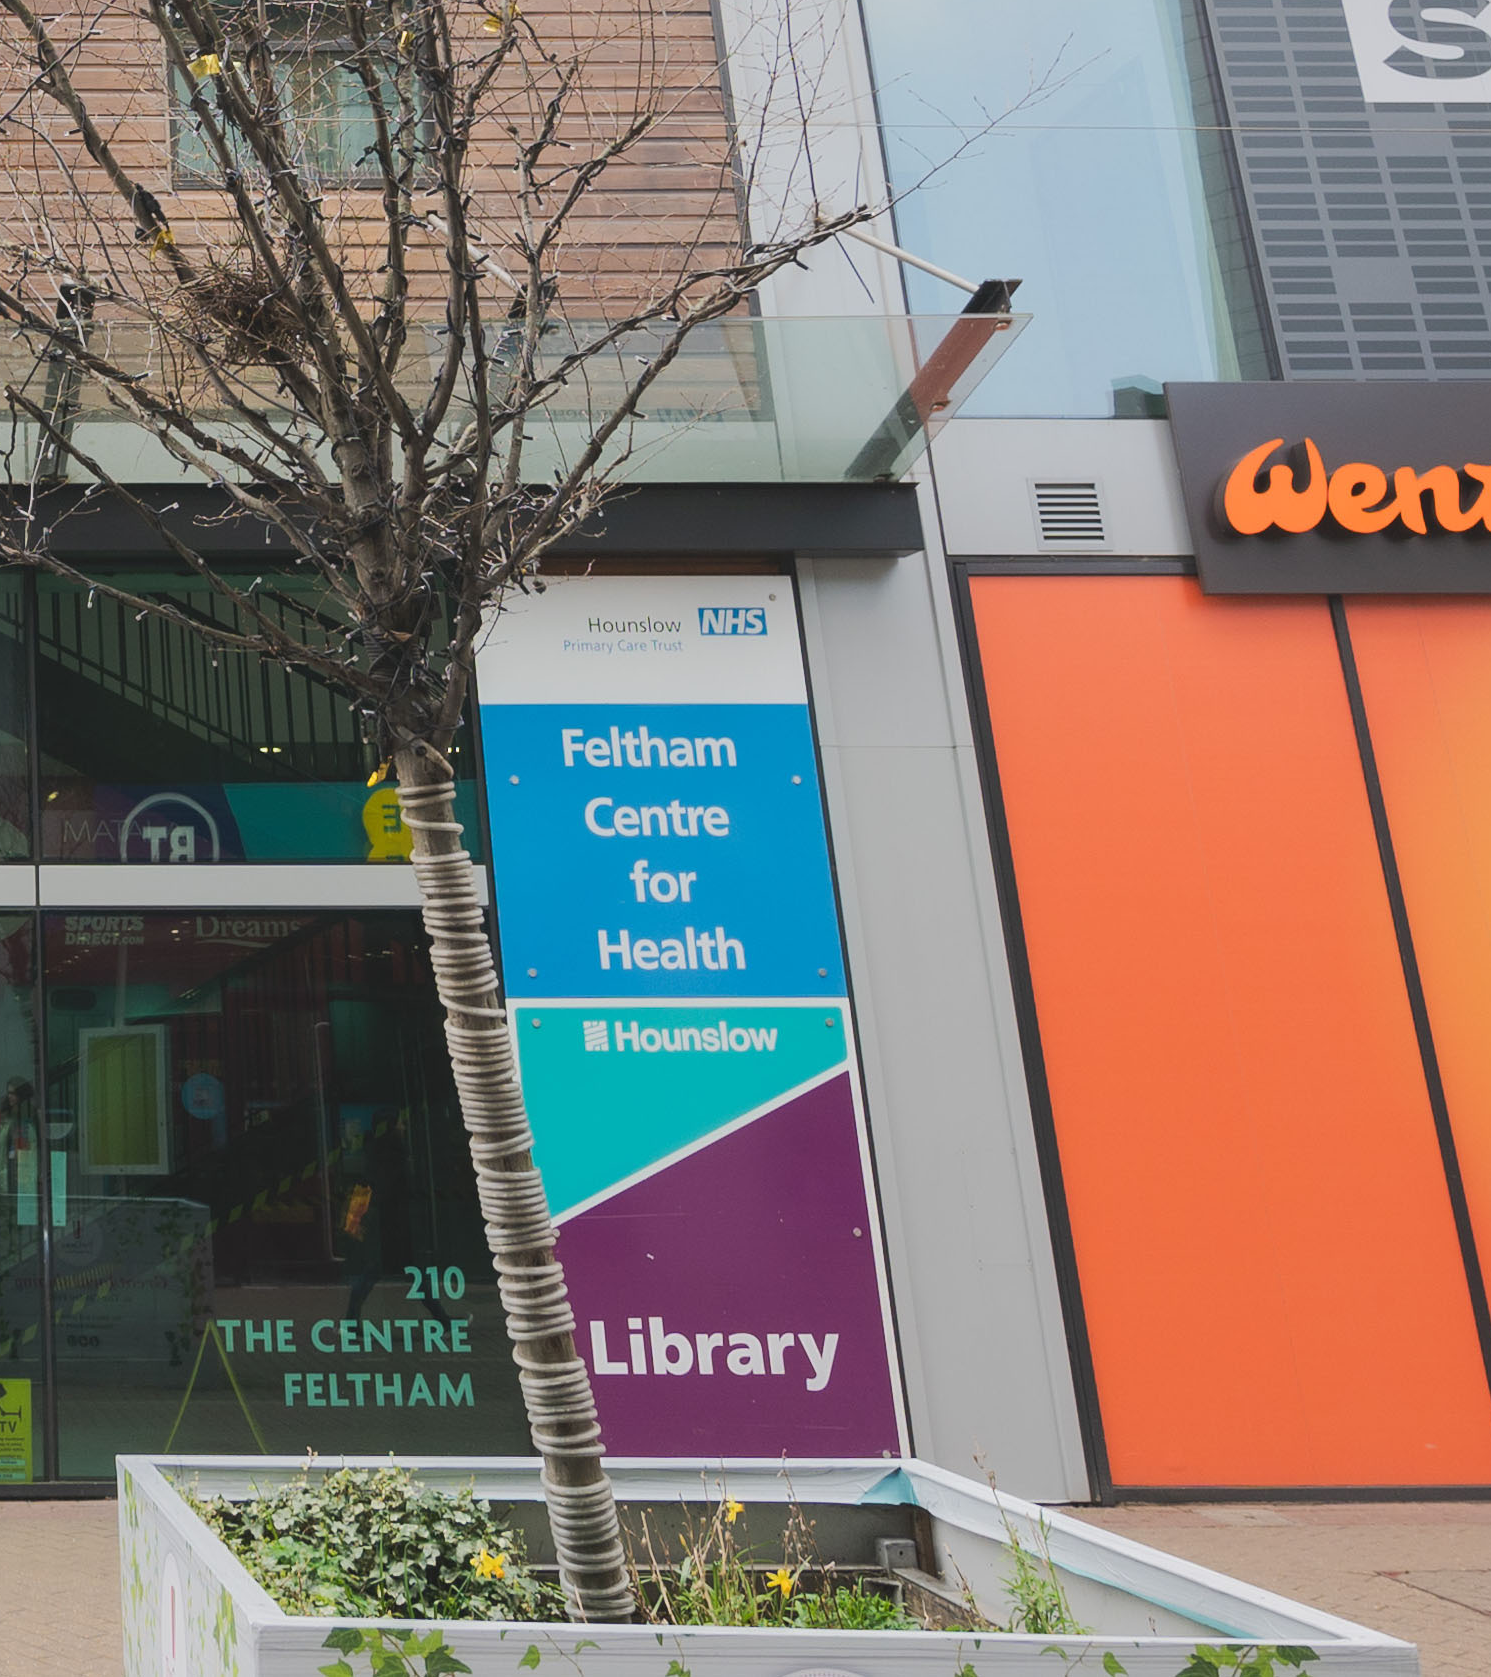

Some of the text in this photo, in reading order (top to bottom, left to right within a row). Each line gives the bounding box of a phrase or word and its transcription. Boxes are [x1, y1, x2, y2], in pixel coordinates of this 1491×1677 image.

[588, 609, 763, 635] Hounslow NHS
[563, 639, 683, 654] Primary Care Trust
[562, 726, 737, 767] Feltham
[585, 797, 730, 837] Centre
[630, 860, 696, 902] for
[65, 916, 145, 931] SPORTS
[598, 927, 746, 970] Health
[616, 1021, 778, 1052] Hounslow
[404, 1266, 465, 1300] 210
[217, 1319, 472, 1353] THE CENTRE
[589, 1317, 839, 1392] Library
[285, 1373, 475, 1407] FELTHAM
